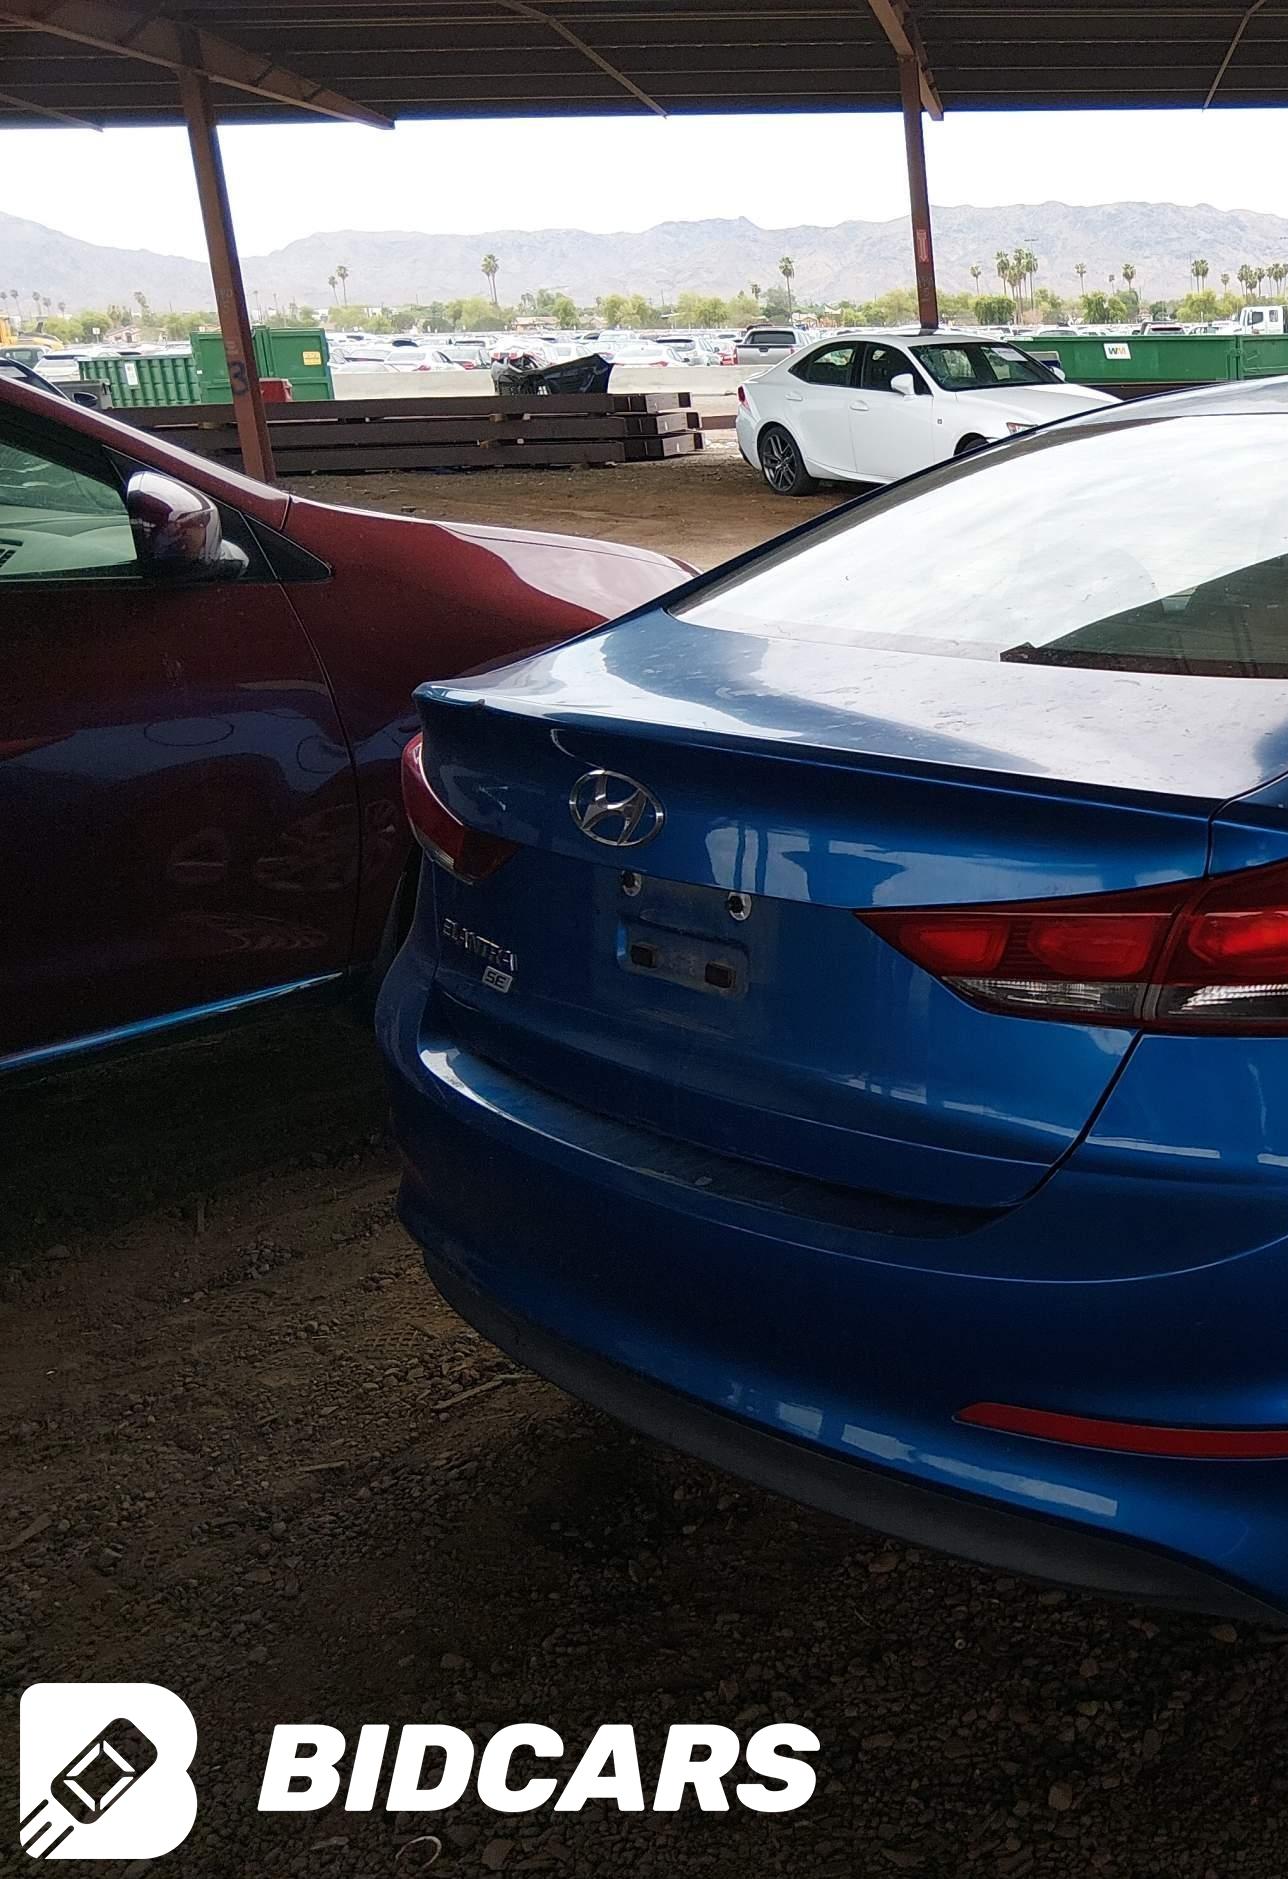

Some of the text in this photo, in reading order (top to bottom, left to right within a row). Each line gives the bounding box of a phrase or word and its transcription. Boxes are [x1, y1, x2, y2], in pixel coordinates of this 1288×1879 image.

[1108, 346, 1127, 355] WM
[228, 360, 249, 396] 3
[485, 971, 507, 989] SE
